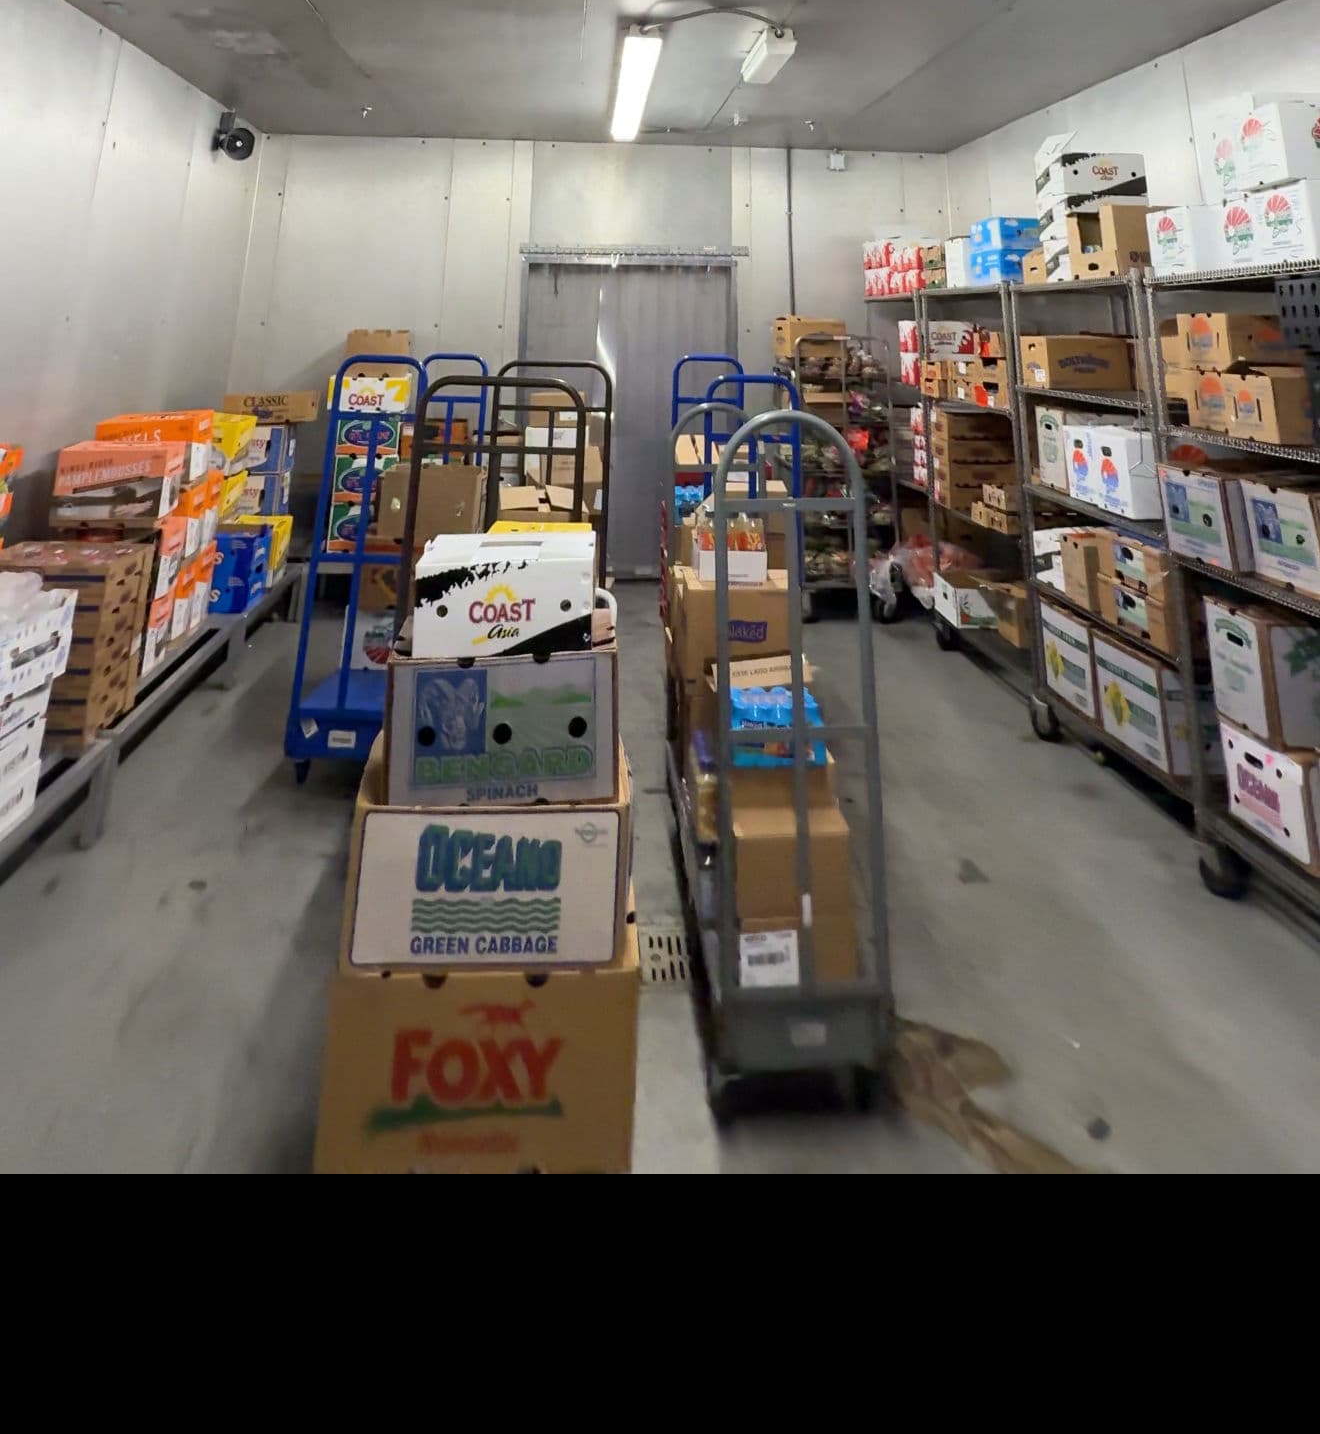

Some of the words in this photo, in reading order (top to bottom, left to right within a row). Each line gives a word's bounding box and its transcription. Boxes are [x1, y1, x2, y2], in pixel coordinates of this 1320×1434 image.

[243, 395, 288, 408] CLASSIC
[348, 394, 385, 406] COAST
[468, 598, 536, 623] COAST
[487, 624, 520, 640] Asia
[415, 745, 594, 783] BENGARD
[466, 783, 539, 802] SPINACH
[415, 824, 563, 894] OCEANO
[410, 936, 469, 955] GREEN
[475, 935, 558, 955] CABBAGE
[390, 1027, 566, 1104] FOXY
